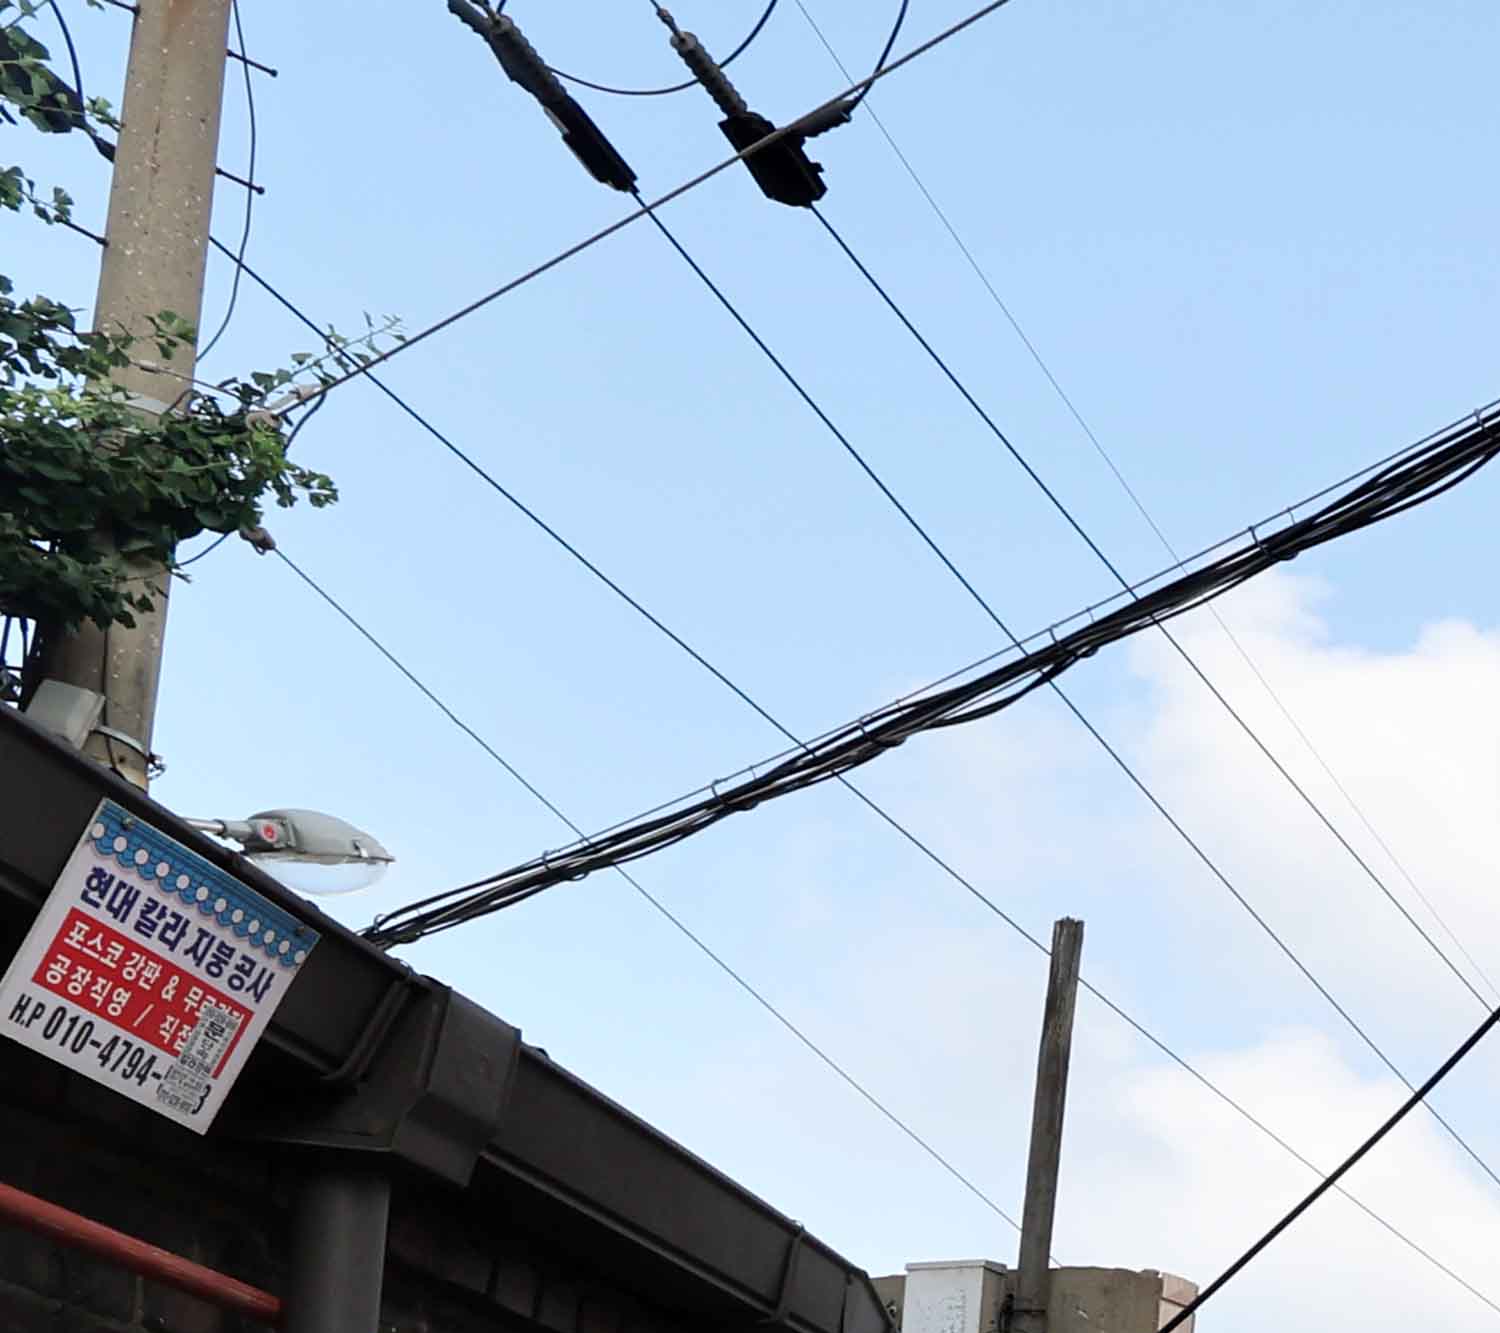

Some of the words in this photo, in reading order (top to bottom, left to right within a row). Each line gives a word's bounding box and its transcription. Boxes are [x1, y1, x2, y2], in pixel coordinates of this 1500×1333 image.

[80, 866, 141, 925] 현대
[133, 896, 191, 953] 칼라
[45, 952, 132, 1018] 공장직영
[63, 919, 125, 969] 포스코
[121, 950, 164, 991] 강판
[160, 974, 181, 1003] &
